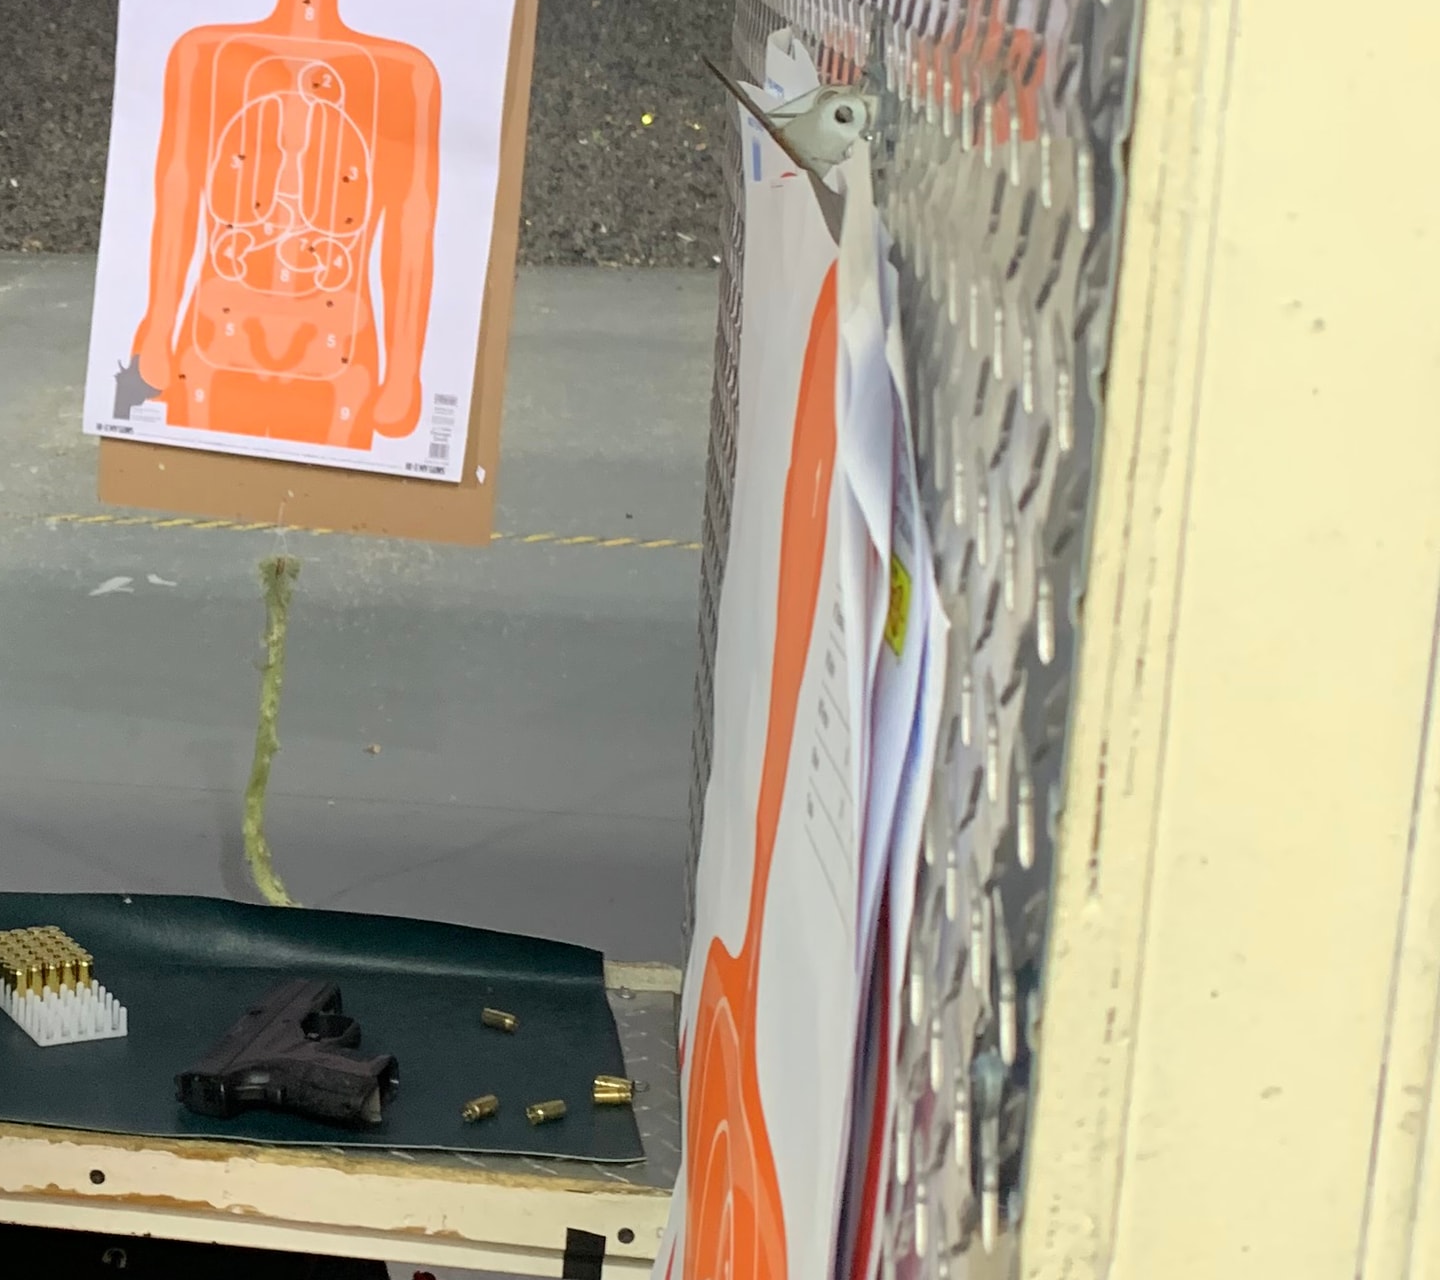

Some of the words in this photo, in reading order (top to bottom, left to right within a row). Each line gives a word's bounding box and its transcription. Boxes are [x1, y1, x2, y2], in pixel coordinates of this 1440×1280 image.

[322, 74, 332, 89] 2
[348, 167, 359, 181] 3
[195, 388, 205, 402] 9
[339, 406, 350, 420] 9
